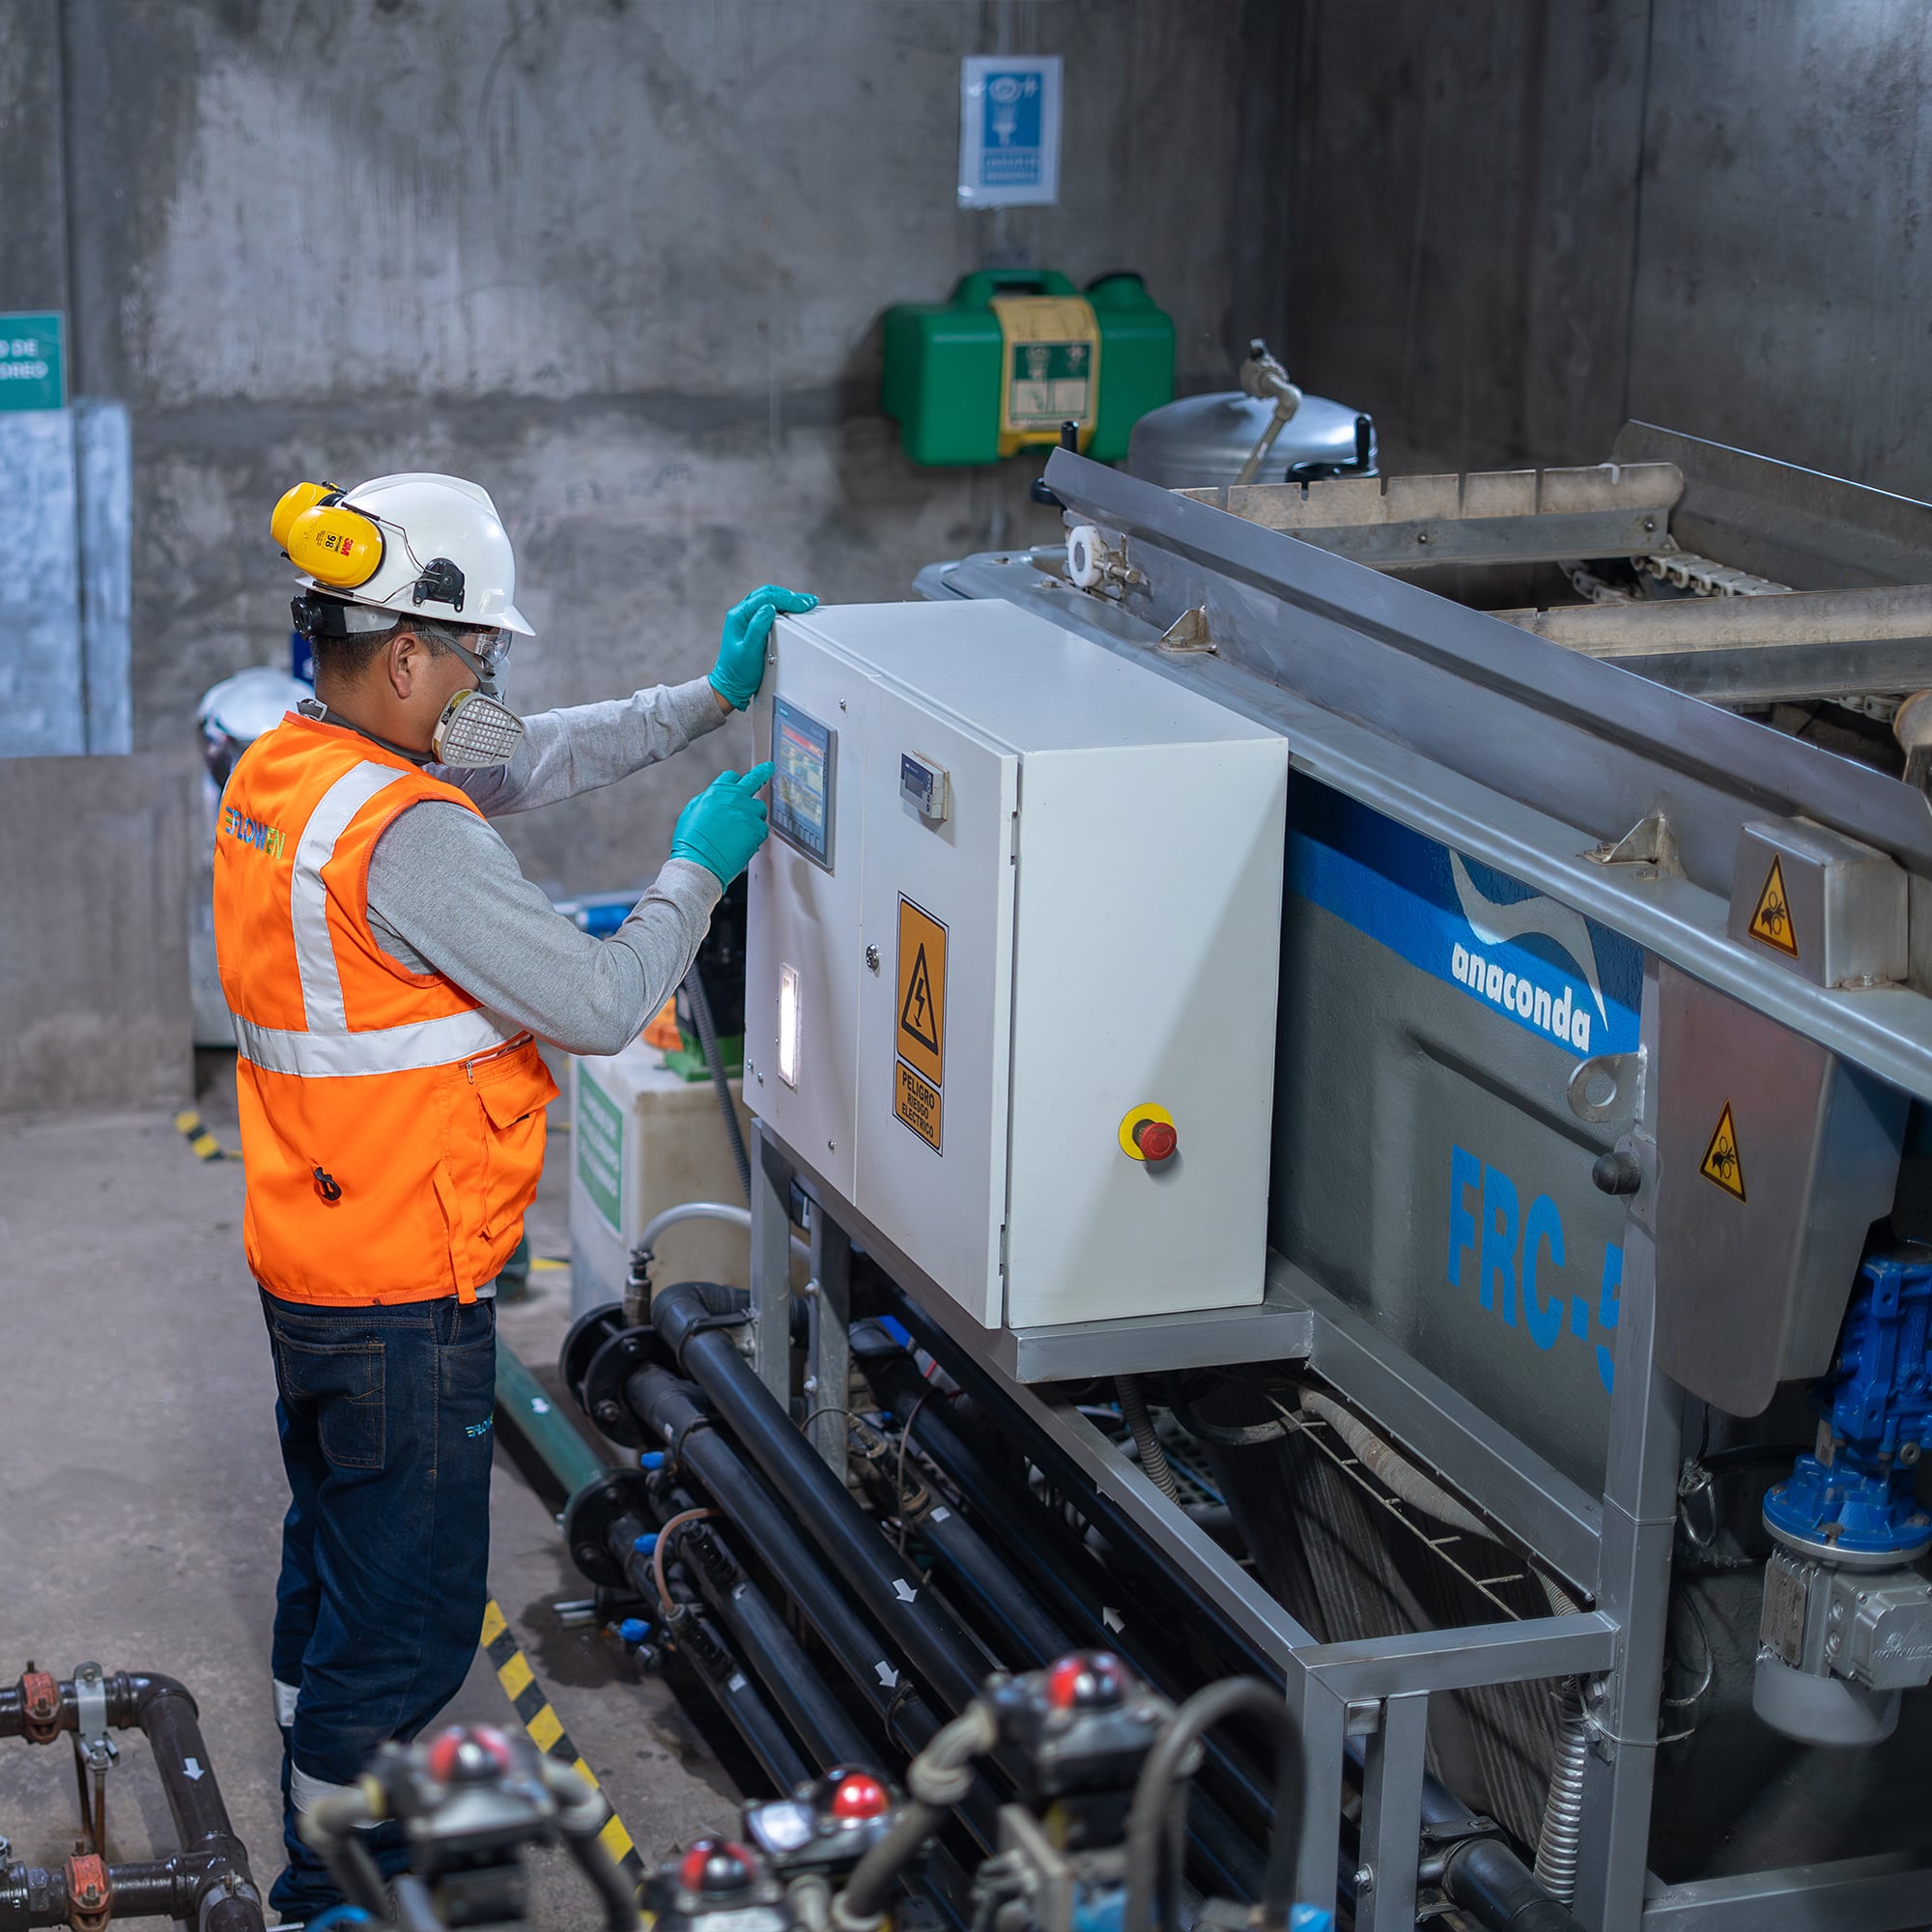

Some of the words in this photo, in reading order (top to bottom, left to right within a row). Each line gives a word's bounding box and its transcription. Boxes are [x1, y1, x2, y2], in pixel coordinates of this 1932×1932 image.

[325, 534, 336, 548] 98
[340, 537, 355, 556] 3M
[1451, 942, 1591, 1053] anaconda
[901, 1069, 935, 1110] PELIGRO
[906, 1092, 929, 1120] RIESGO
[901, 1101, 934, 1139] ELECTRICO
